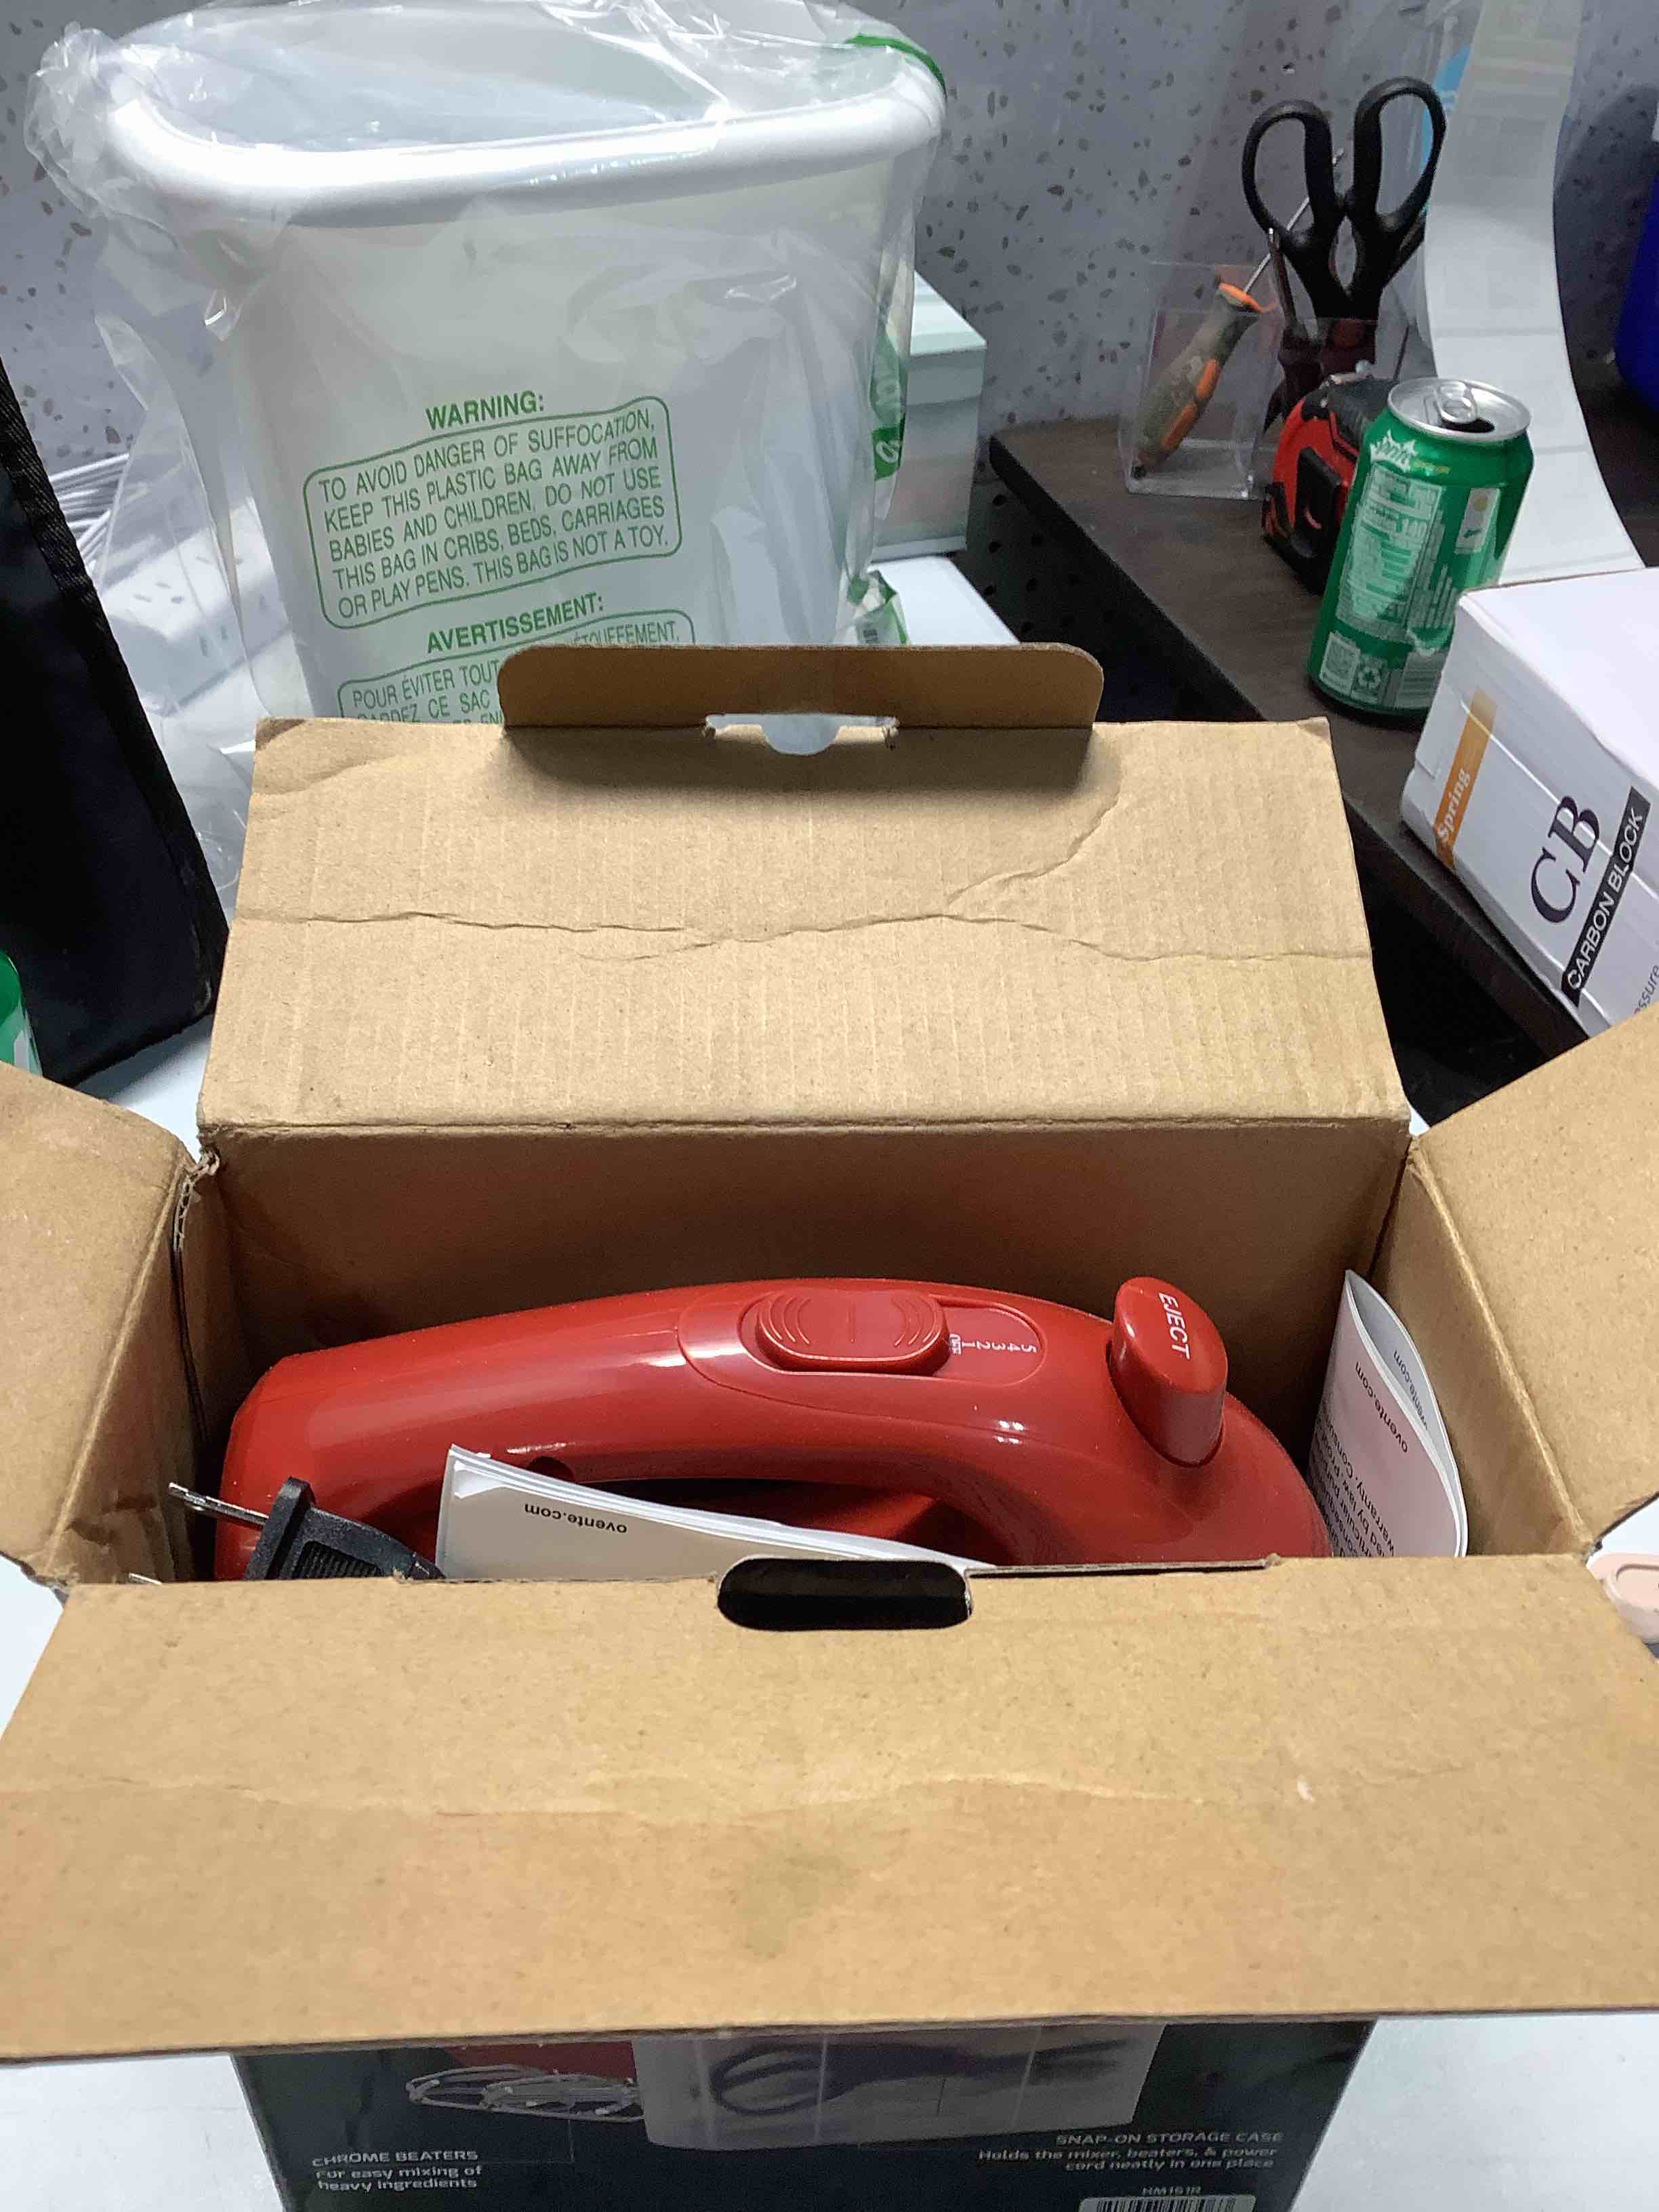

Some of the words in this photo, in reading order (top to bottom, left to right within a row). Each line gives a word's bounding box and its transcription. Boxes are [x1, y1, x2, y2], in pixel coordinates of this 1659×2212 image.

[426, 390, 544, 430] WARNING:
[319, 476, 346, 503] TO
[356, 460, 407, 495] AVOID
[413, 438, 485, 478] DANGER
[494, 432, 518, 457] OF
[528, 409, 655, 453] SUFFOCATION,
[324, 501, 373, 533] KEEP
[382, 487, 420, 518] THIS
[426, 466, 495, 505] PLASTIC
[504, 459, 542, 485] BAG
[552, 450, 601, 478] AWAY
[609, 436, 657, 466] FROM
[329, 526, 394, 562] BABIES
[404, 512, 437, 542] AND
[545, 483, 571, 507] DO
[581, 472, 615, 499] NOT
[623, 466, 661, 491] USE
[332, 562, 376, 591] THIS
[381, 548, 416, 578] BAG
[422, 541, 438, 565] IN
[444, 528, 504, 560] CRIBS,
[507, 514, 556, 546] BEDS,
[561, 495, 665, 532] CARRIAGES
[339, 594, 367, 619] OR
[371, 579, 411, 612] PLAY
[415, 565, 470, 596] PENS.
[473, 555, 513, 584] THIS
[516, 546, 552, 575] BAG
[554, 541, 569, 565] IS
[573, 531, 607, 558] NOT
[614, 529, 626, 551] A
[628, 525, 668, 548] TOY.
[426, 592, 604, 653] AVERTISSEMENT:
[352, 684, 398, 710] POUR
[401, 668, 455, 700] ÉVITER
[459, 659, 499, 686] TOUT
[428, 695, 451, 719] CE
[459, 689, 490, 714] SAC
[1437, 768, 1471, 844] Spring
[1530, 795, 1600, 924] CB
[1566, 891, 1615, 989] CARBON
[1609, 806, 1643, 886] BLOCK
[977, 1340, 991, 1350] 2
[991, 1341, 1006, 1351] 3
[1159, 1292, 1191, 1361] EJECT
[1007, 1343, 1021, 1352] 4
[1021, 1344, 1037, 1353] 5
[1355, 1362, 1408, 1453] ovente.com
[525, 1503, 628, 1534] ovente.com
[312, 2152, 390, 2167] CHROME
[395, 2150, 478, 2163] BEATERS
[1034, 2149, 1063, 2160] the
[1204, 2148, 1217, 2158] &
[1222, 2147, 1278, 2160] power
[1055, 2134, 1141, 2146] SNAP-ON
[1146, 2132, 1228, 2144] STORAGE
[1235, 2131, 1285, 2142] CASE
[350, 2169, 393, 2180] easy
[398, 2166, 459, 2178] mixing
[464, 2165, 482, 2176] of
[1109, 2159, 1164, 2171] neatly
[1170, 2159, 1185, 2169] in
[1190, 2159, 1222, 2169] one
[1225, 2158, 1274, 2170] place
[318, 2180, 372, 2193] heavy
[377, 2179, 478, 2192] ingredients
